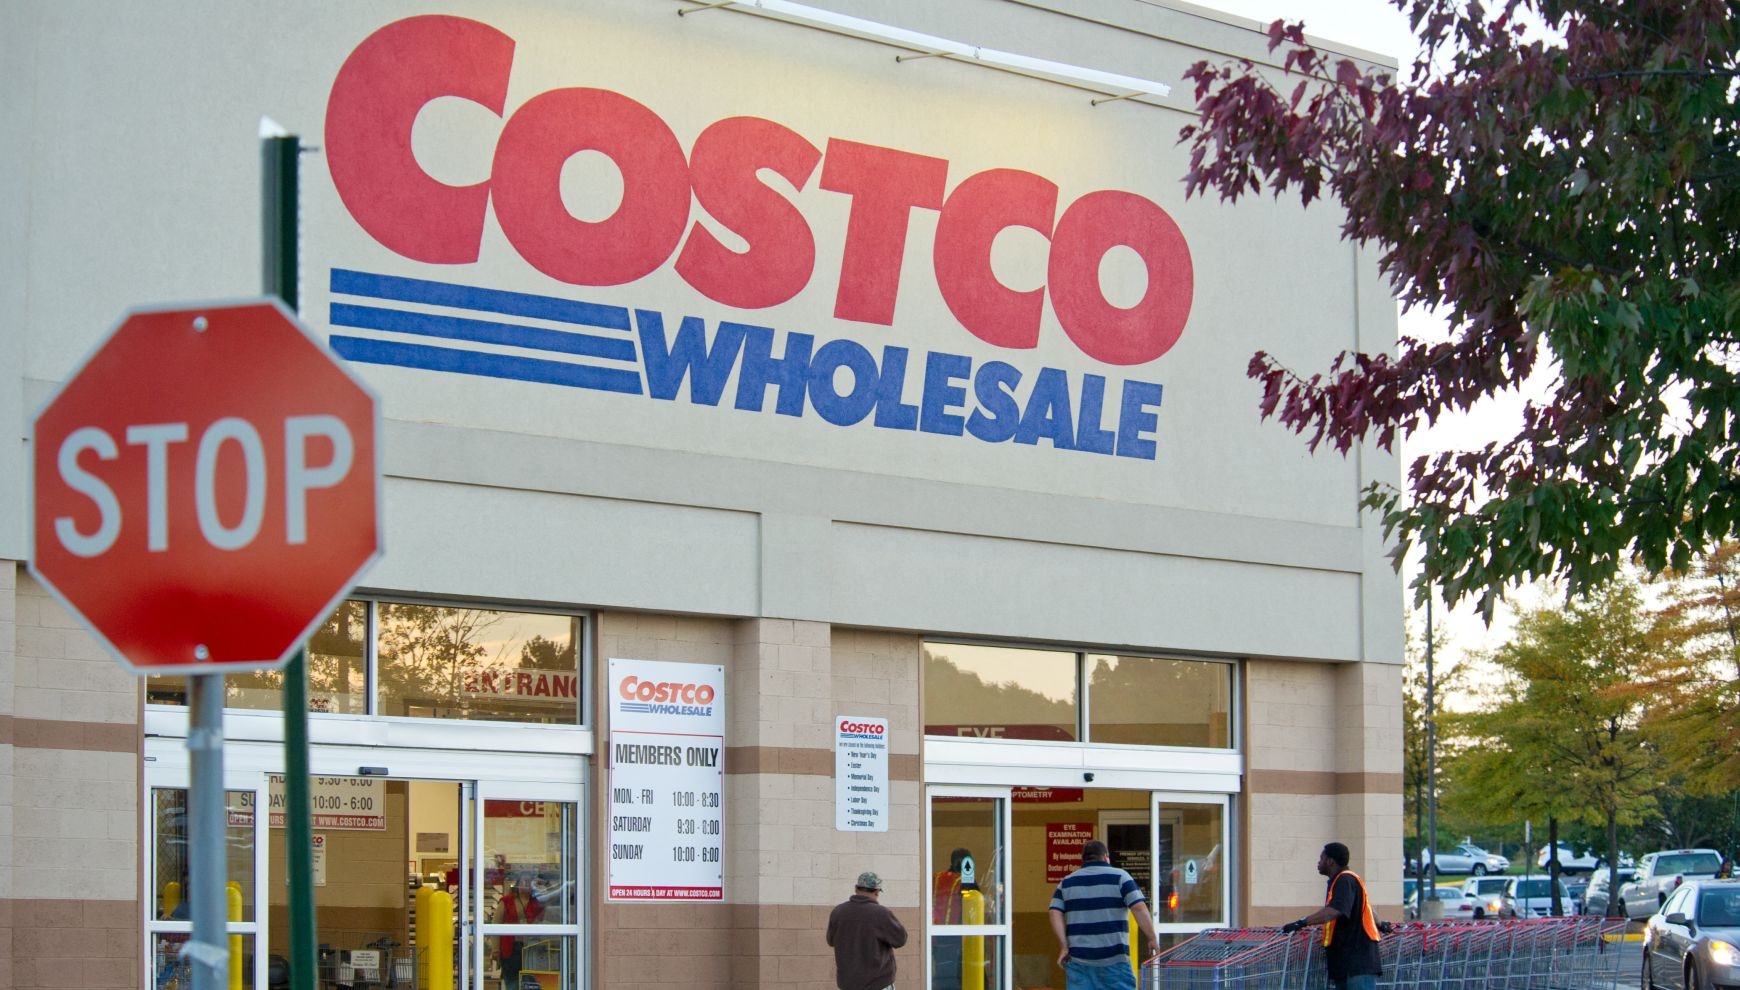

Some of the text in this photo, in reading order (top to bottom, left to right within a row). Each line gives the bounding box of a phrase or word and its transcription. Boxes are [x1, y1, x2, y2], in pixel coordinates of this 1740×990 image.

[325, 14, 1194, 366] COSTCO
[635, 309, 1162, 460] WHOLESALE
[55, 414, 355, 557] STOP
[619, 675, 714, 705] COSTCO
[648, 703, 712, 717] WHOLESALE
[840, 720, 884, 734] COSTCO
[615, 743, 719, 767] MEMBERS ONLY
[313, 795, 341, 810] 10:00
[350, 796, 373, 811] 6:00
[613, 788, 634, 804] MON.
[641, 789, 654, 805] FRI
[672, 791, 695, 807] 10:00
[701, 792, 719, 808] 8:30
[1011, 791, 1053, 799] PTOMETRY
[319, 815, 384, 827] WWW.COSTCO.COM
[613, 816, 652, 832] SATURDAY
[677, 818, 695, 835] 9:30
[612, 844, 643, 860] SUNDAY
[672, 846, 695, 862] 10:00
[702, 847, 719, 863] 6:00
